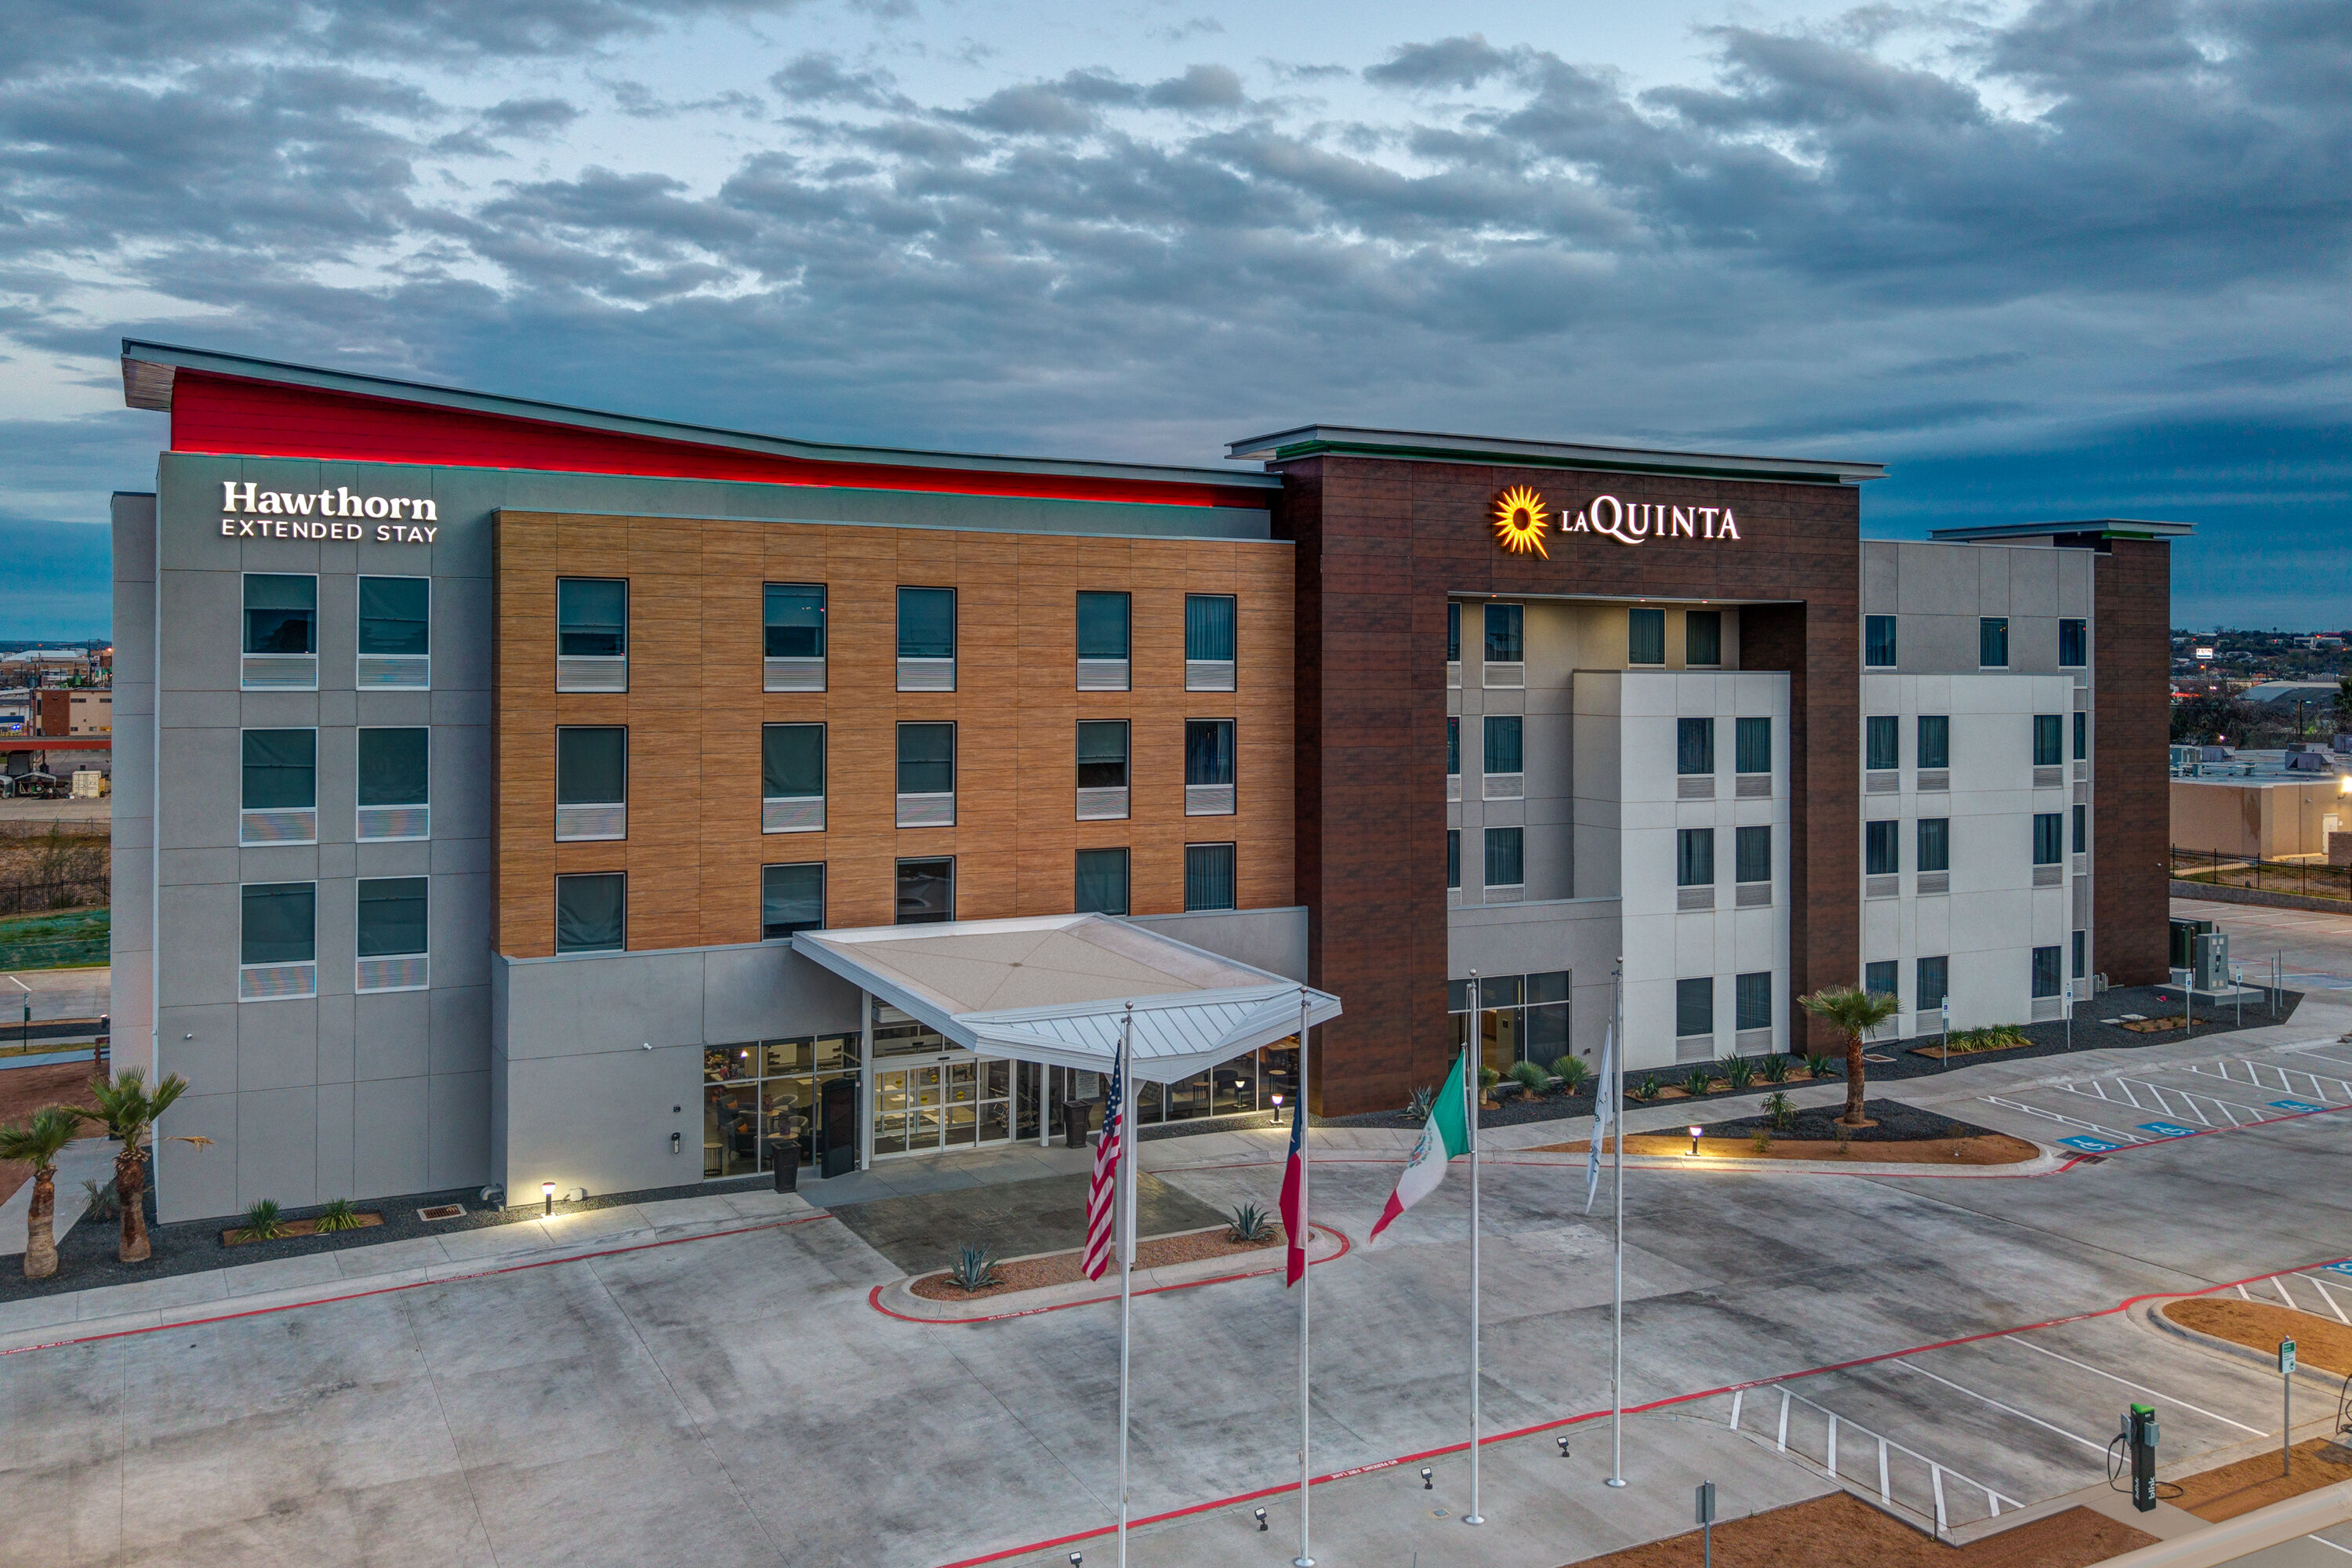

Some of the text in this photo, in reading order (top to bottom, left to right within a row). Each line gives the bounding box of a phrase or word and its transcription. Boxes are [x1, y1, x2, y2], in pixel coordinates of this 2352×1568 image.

[223, 481, 437, 521] Hawthorn
[222, 519, 437, 543] EXTENDED STAY
[1562, 495, 1740, 544] LA QUINTA
[1362, 1462, 1389, 1472] PARKING
